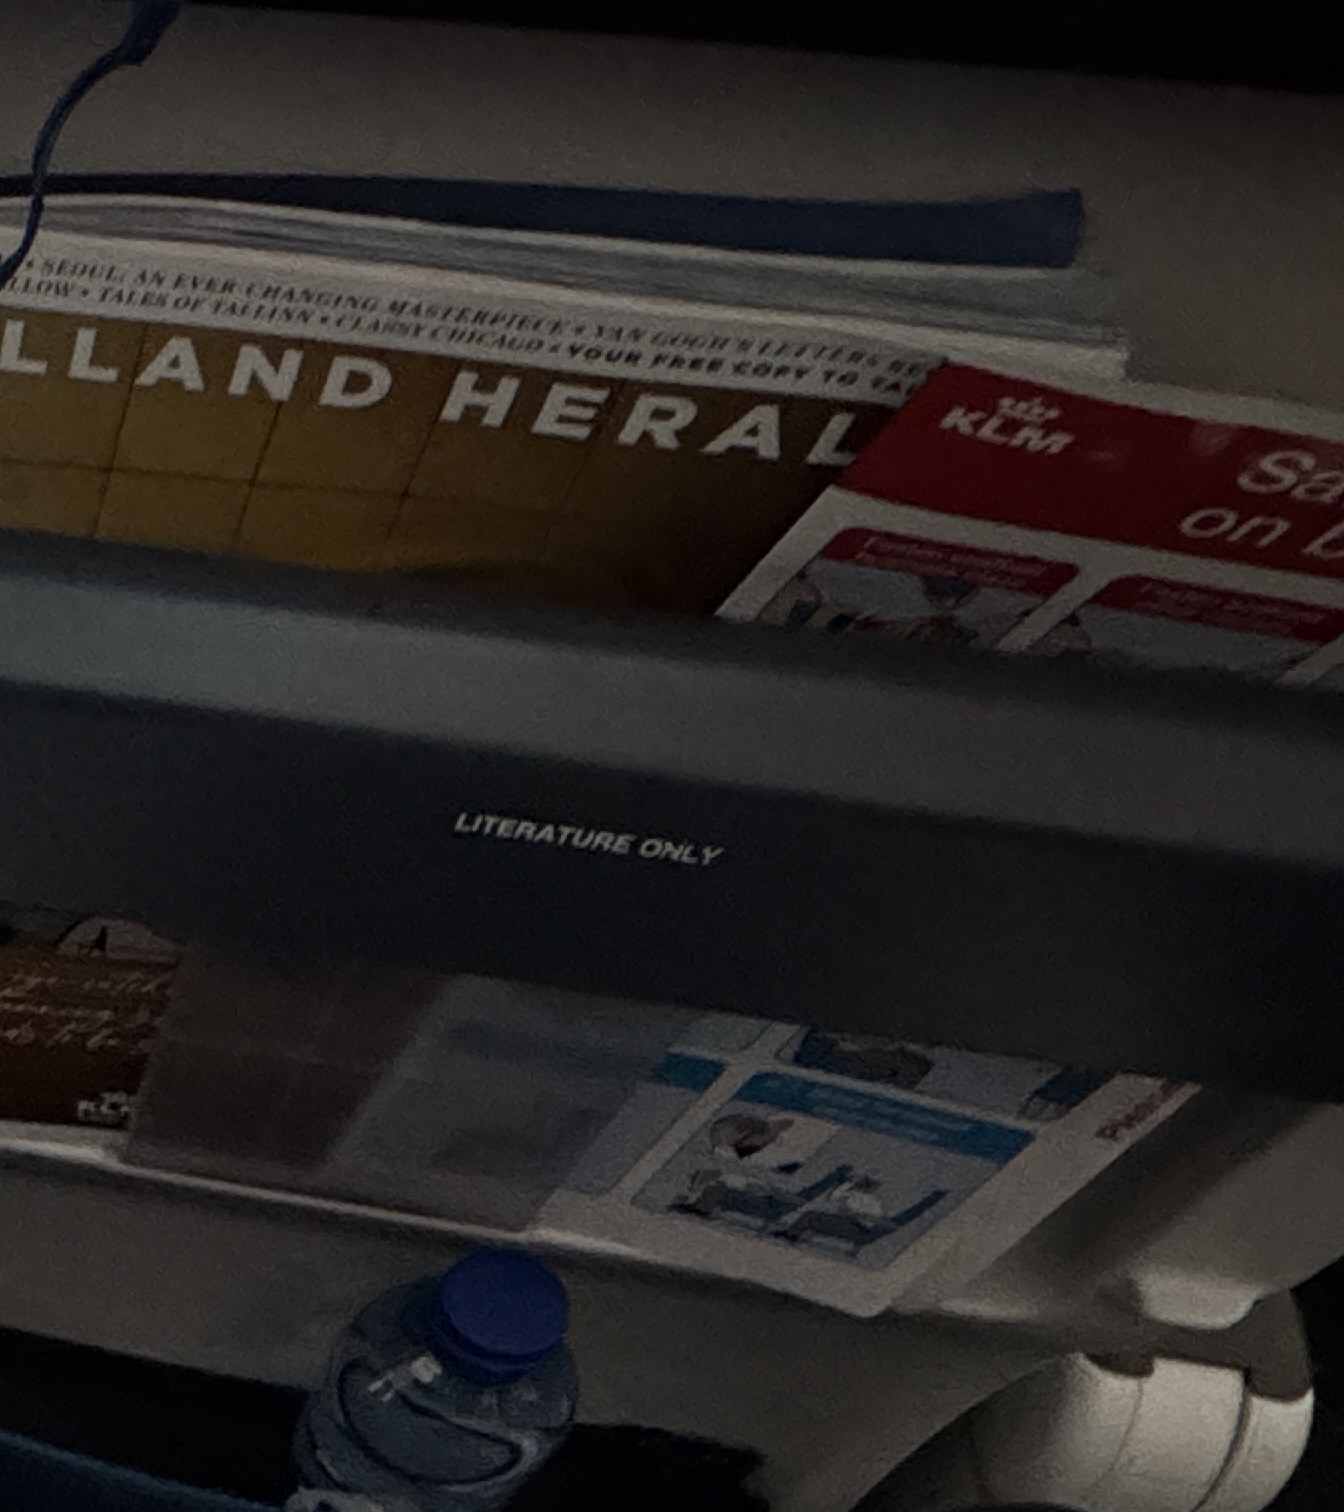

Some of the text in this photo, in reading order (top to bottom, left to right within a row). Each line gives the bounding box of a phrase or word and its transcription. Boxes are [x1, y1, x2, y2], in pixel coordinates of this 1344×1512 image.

[567, 341, 643, 367] YOUR
[649, 352, 725, 375] FREE
[731, 360, 809, 380] COPY
[822, 369, 859, 387] TO
[438, 367, 864, 468] HERAL
[938, 405, 1076, 456] KLM
[1178, 506, 1293, 548] on
[453, 811, 726, 867] LITERATURE ONLY
